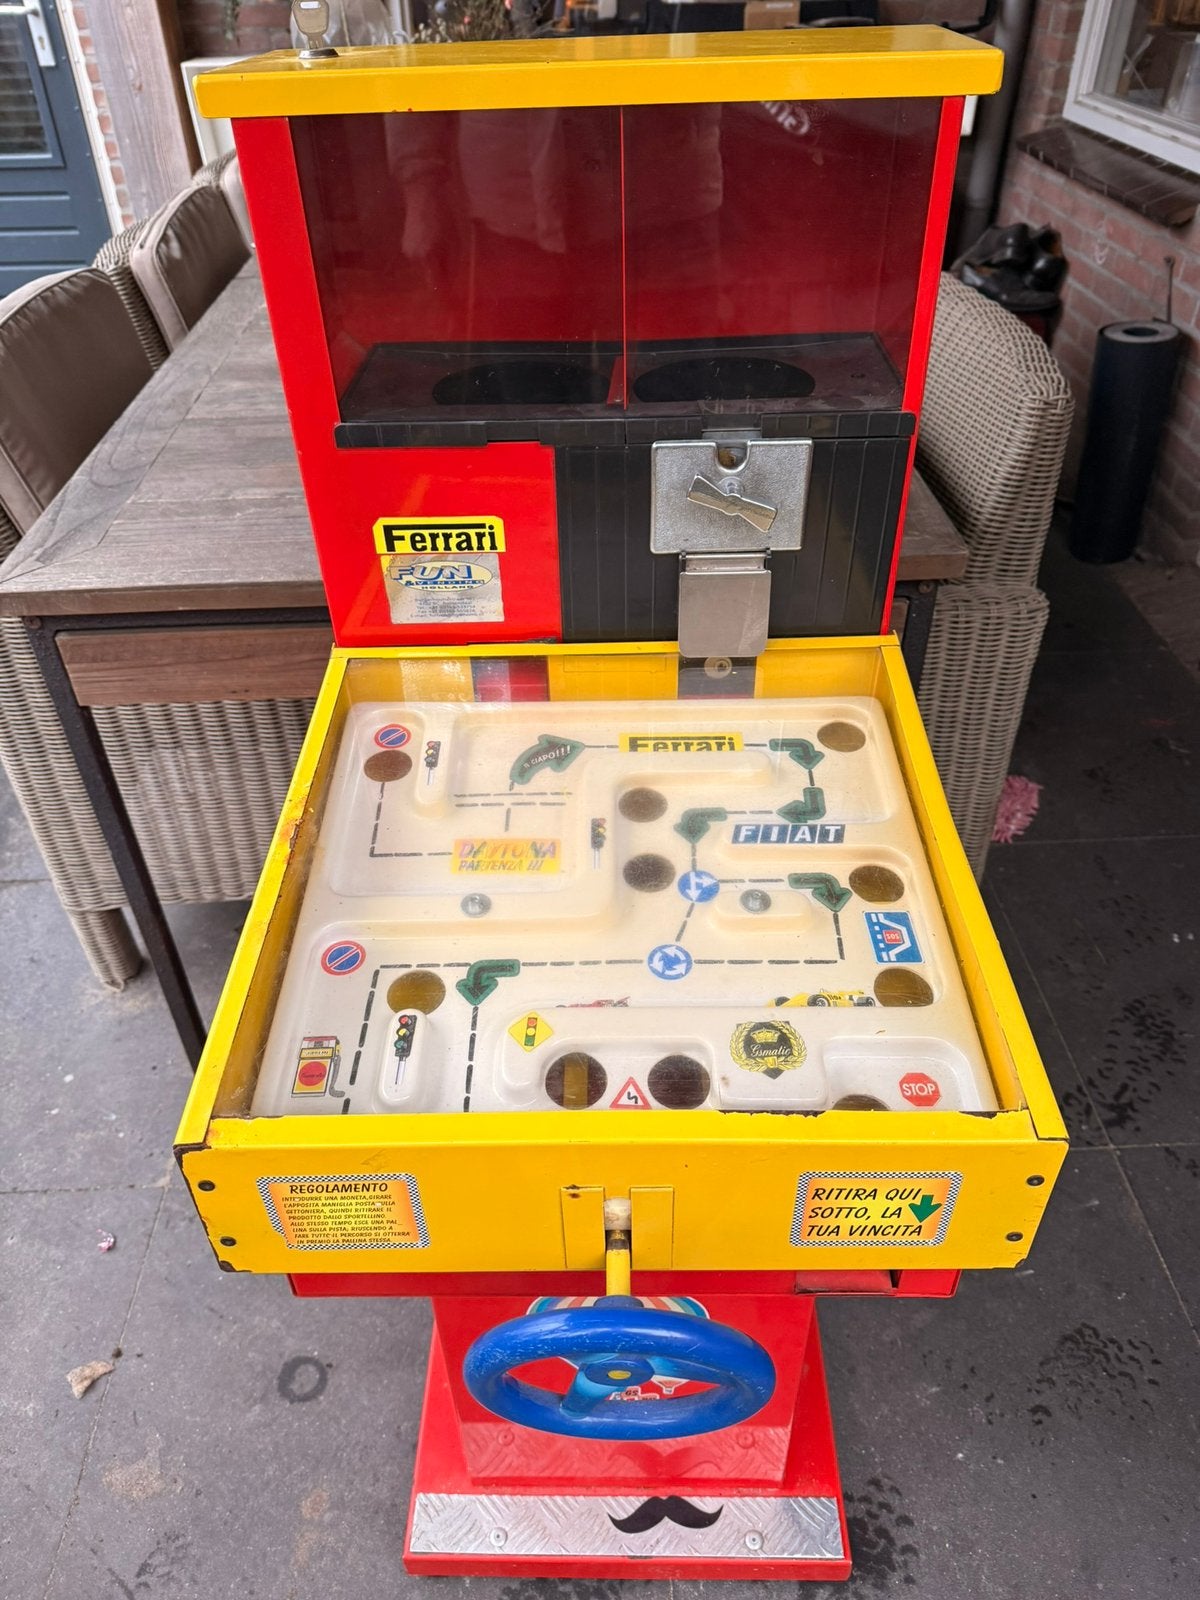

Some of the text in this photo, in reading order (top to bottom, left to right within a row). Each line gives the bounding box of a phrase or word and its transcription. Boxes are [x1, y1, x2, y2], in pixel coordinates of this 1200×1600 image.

[383, 523, 498, 552] Ferrari
[389, 564, 473, 581] FUN
[628, 736, 736, 752] Ferrari
[737, 825, 842, 842] FIAT
[750, 1044, 792, 1057] Gsmatic
[901, 1080, 937, 1096] STOP
[289, 1182, 388, 1194] REGOLAMENTO
[811, 1188, 922, 1201] RITIRA QUI
[808, 1206, 903, 1220] SOTTO, LA
[806, 1224, 923, 1237] TUA VINCITA
